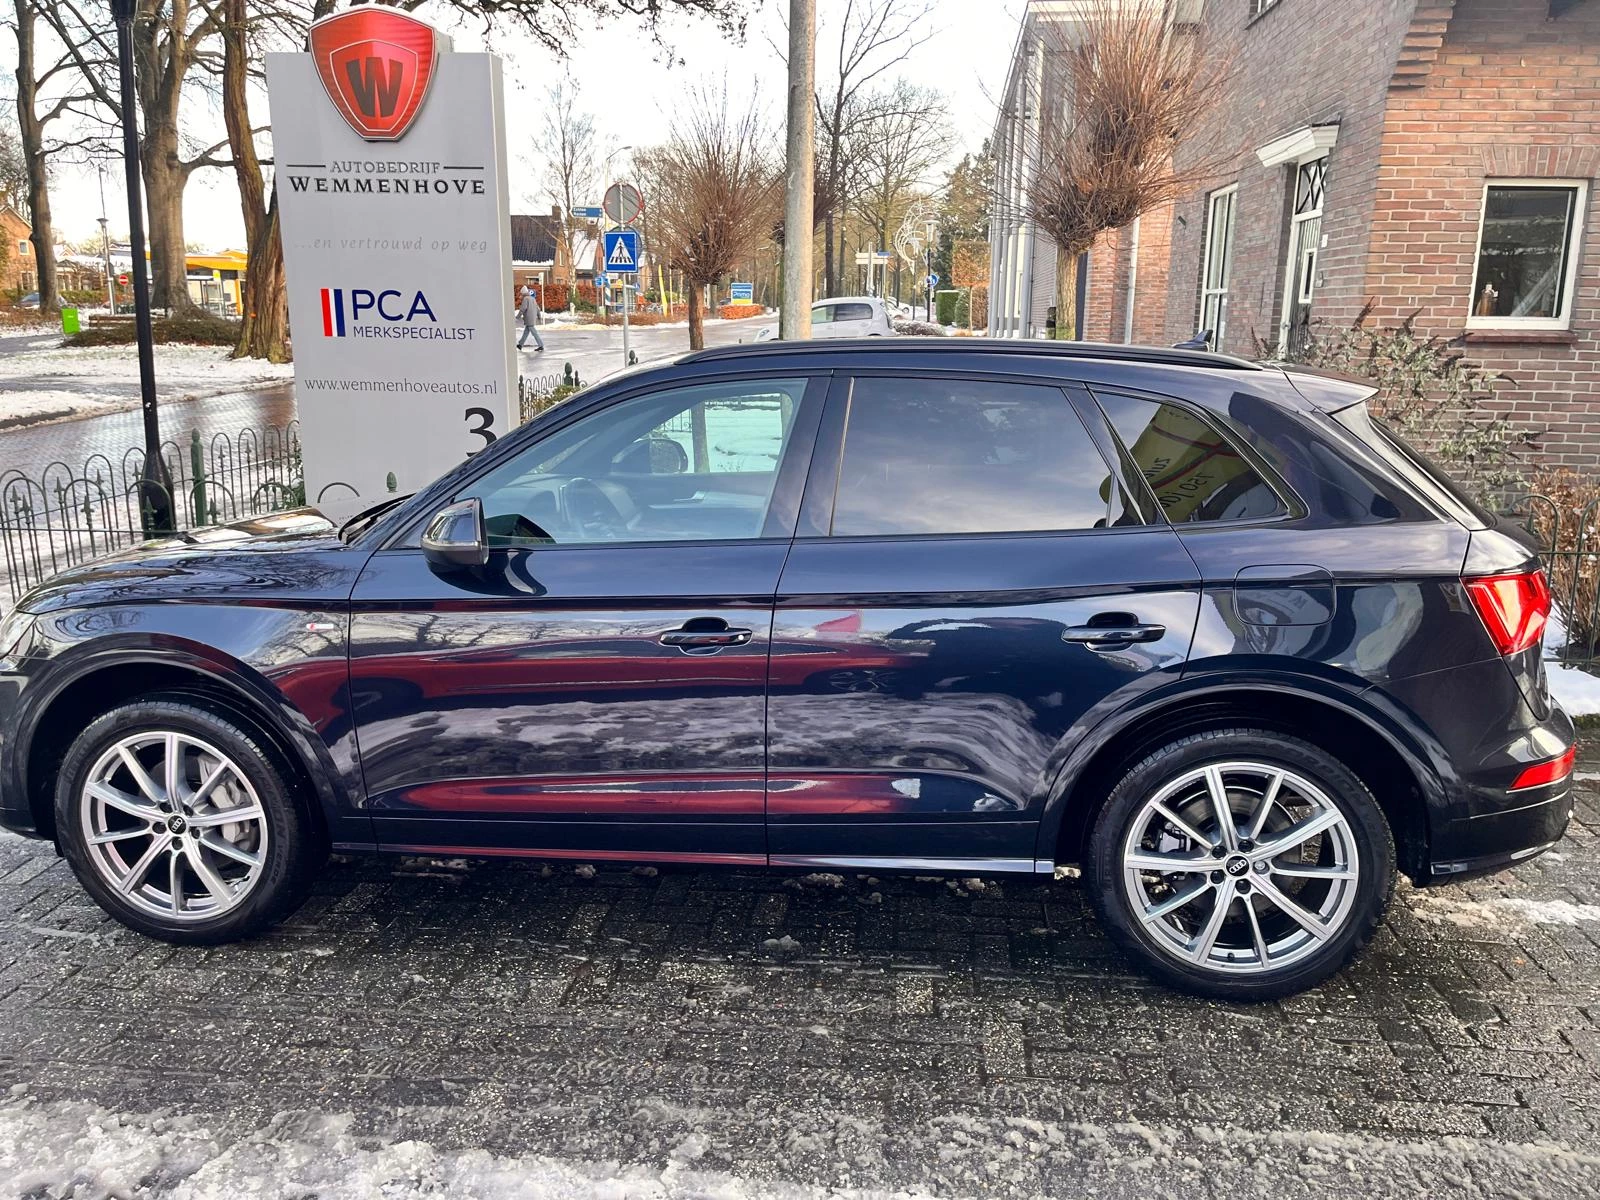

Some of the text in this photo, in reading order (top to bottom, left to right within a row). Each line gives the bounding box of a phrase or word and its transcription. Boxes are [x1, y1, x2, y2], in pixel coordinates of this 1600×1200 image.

[345, 56, 404, 118] W
[330, 161, 440, 174] AUTOBEDRIJF
[289, 176, 485, 195] WEMMENHOVE
[340, 238, 422, 250] vertrouwd
[431, 240, 449, 253] op
[458, 240, 487, 253] weg
[351, 289, 437, 322] PCA
[353, 326, 475, 340] MERKSPECIALIST
[304, 378, 497, 394] www.wemmenhoveautos.nl
[464, 407, 497, 457] 3
